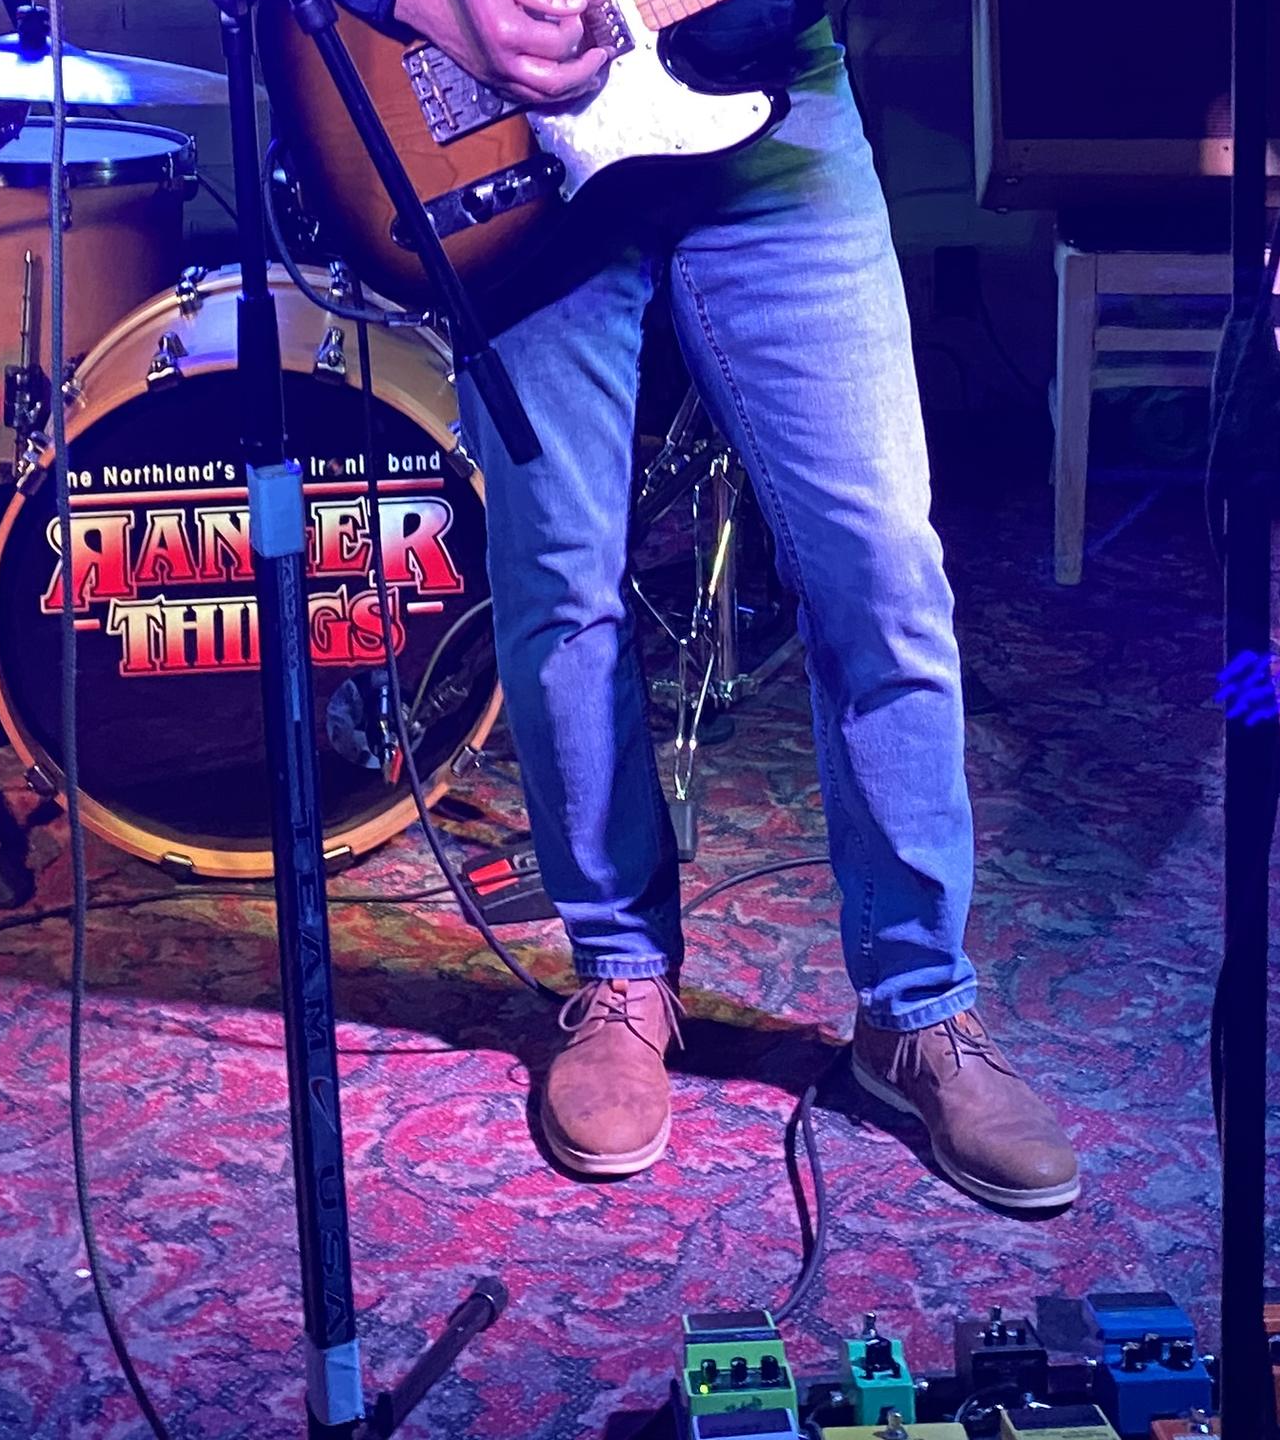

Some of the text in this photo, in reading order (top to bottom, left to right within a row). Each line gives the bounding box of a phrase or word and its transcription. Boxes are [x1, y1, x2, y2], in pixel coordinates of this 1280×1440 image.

[102, 460, 237, 487] Northland's
[387, 450, 441, 474] band
[40, 495, 465, 615] RANER
[106, 584, 407, 678] THIGS
